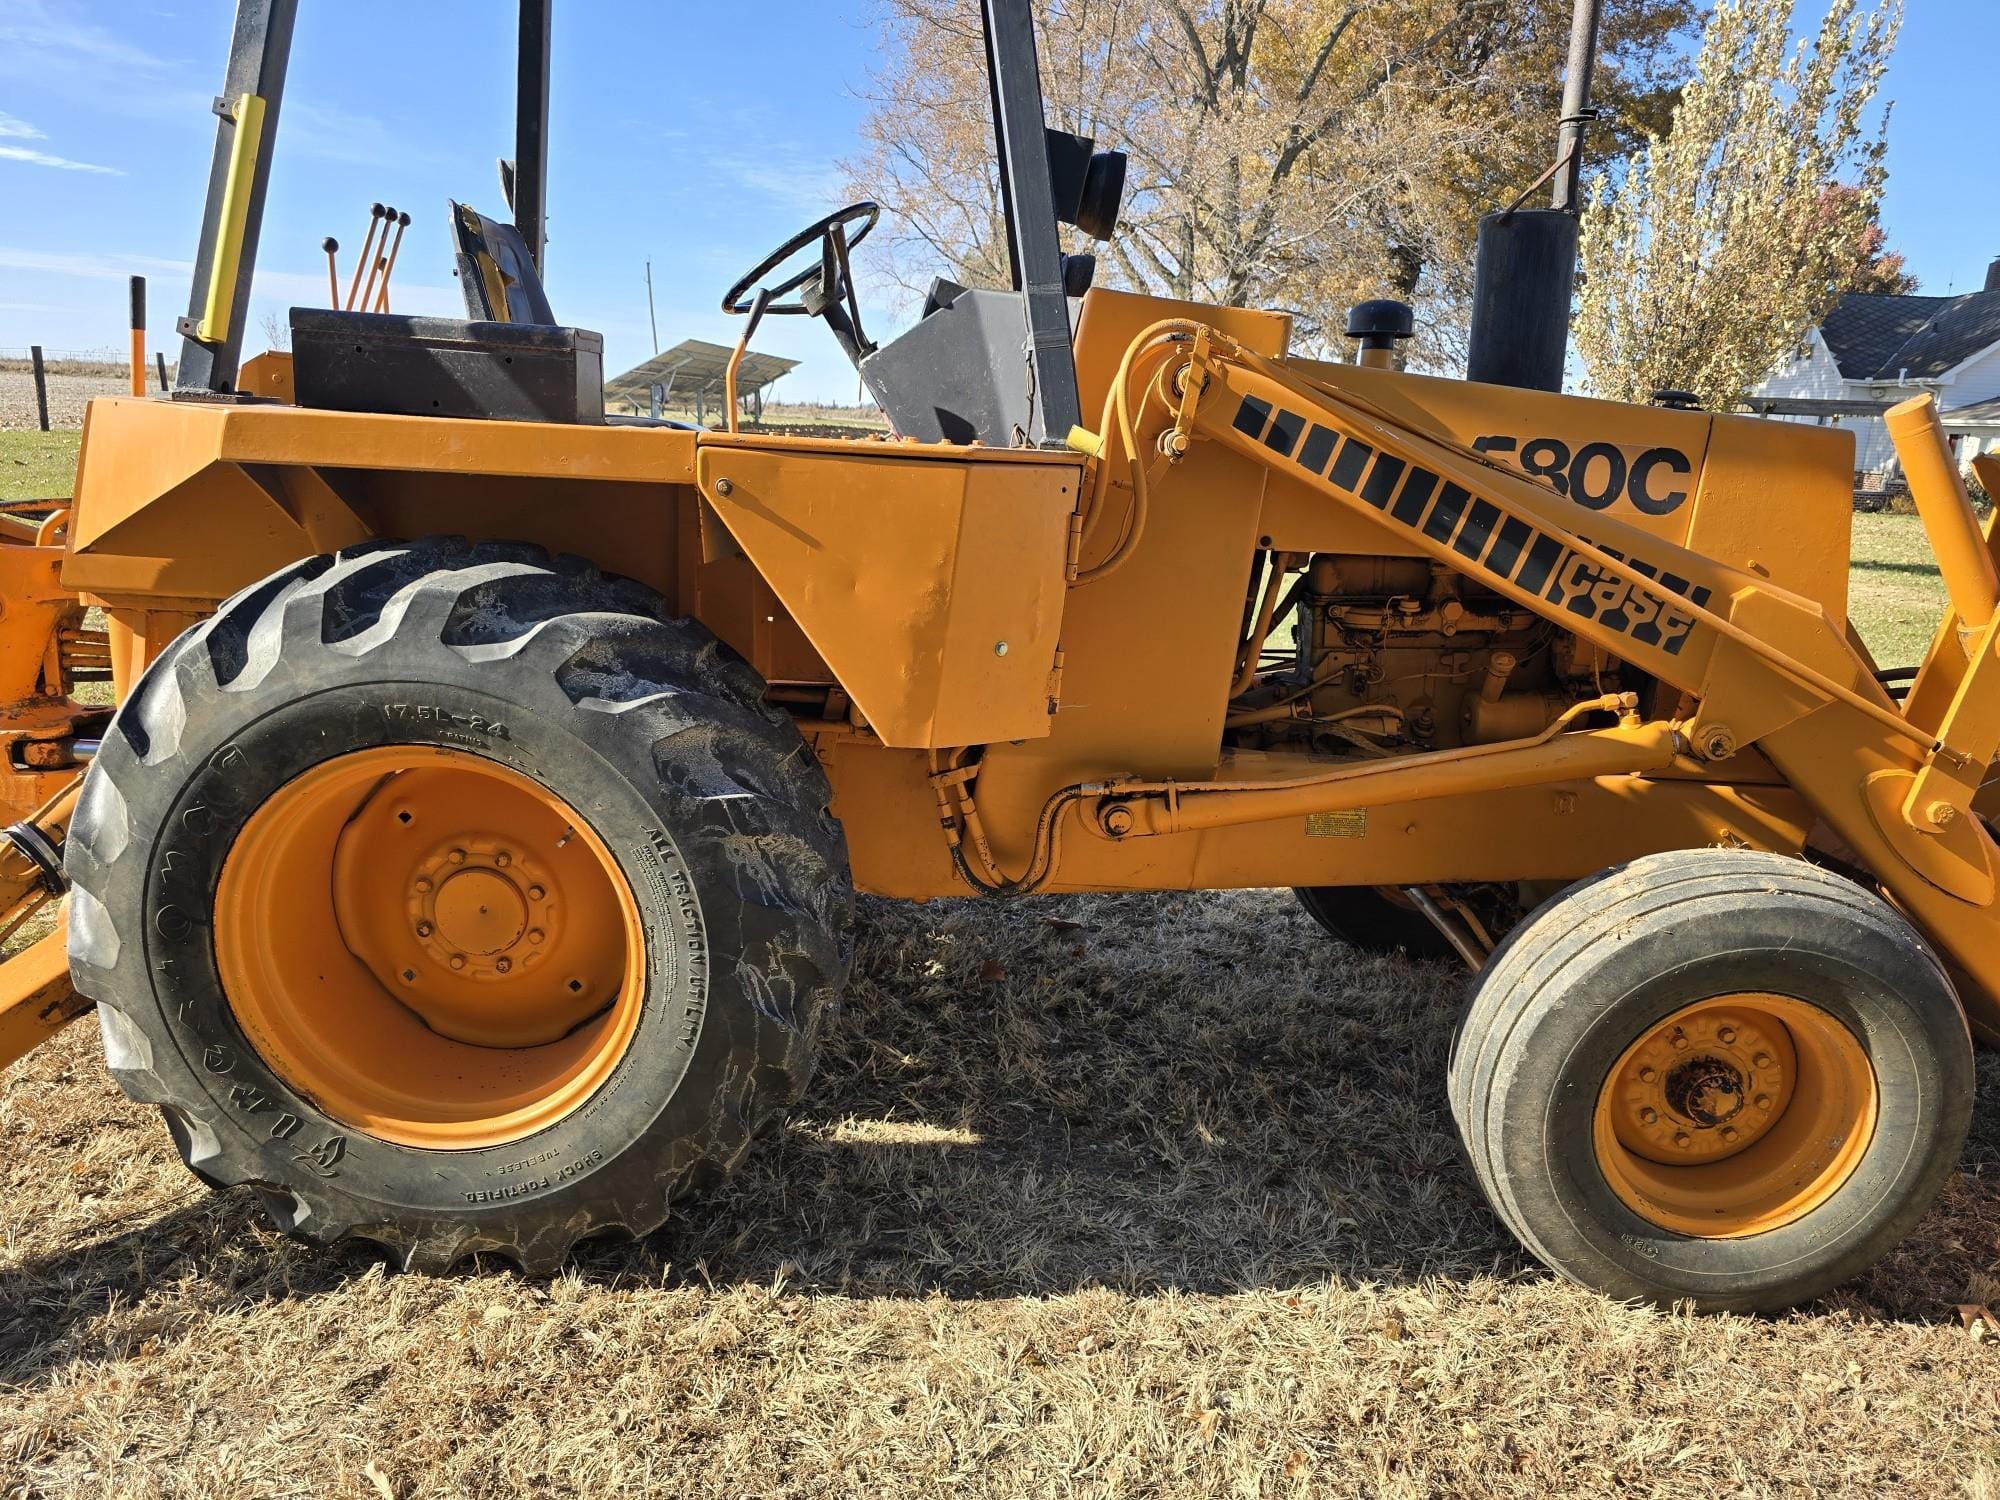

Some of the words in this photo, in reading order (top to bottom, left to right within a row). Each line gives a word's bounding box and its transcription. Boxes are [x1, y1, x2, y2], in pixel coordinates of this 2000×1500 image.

[1557, 551, 1692, 648] case
[644, 826, 677, 865] ALL
[497, 1147, 560, 1175] TUBELESS
[556, 1149, 604, 1182] SHOCK
[465, 1177, 551, 1203] FORTIFIED
